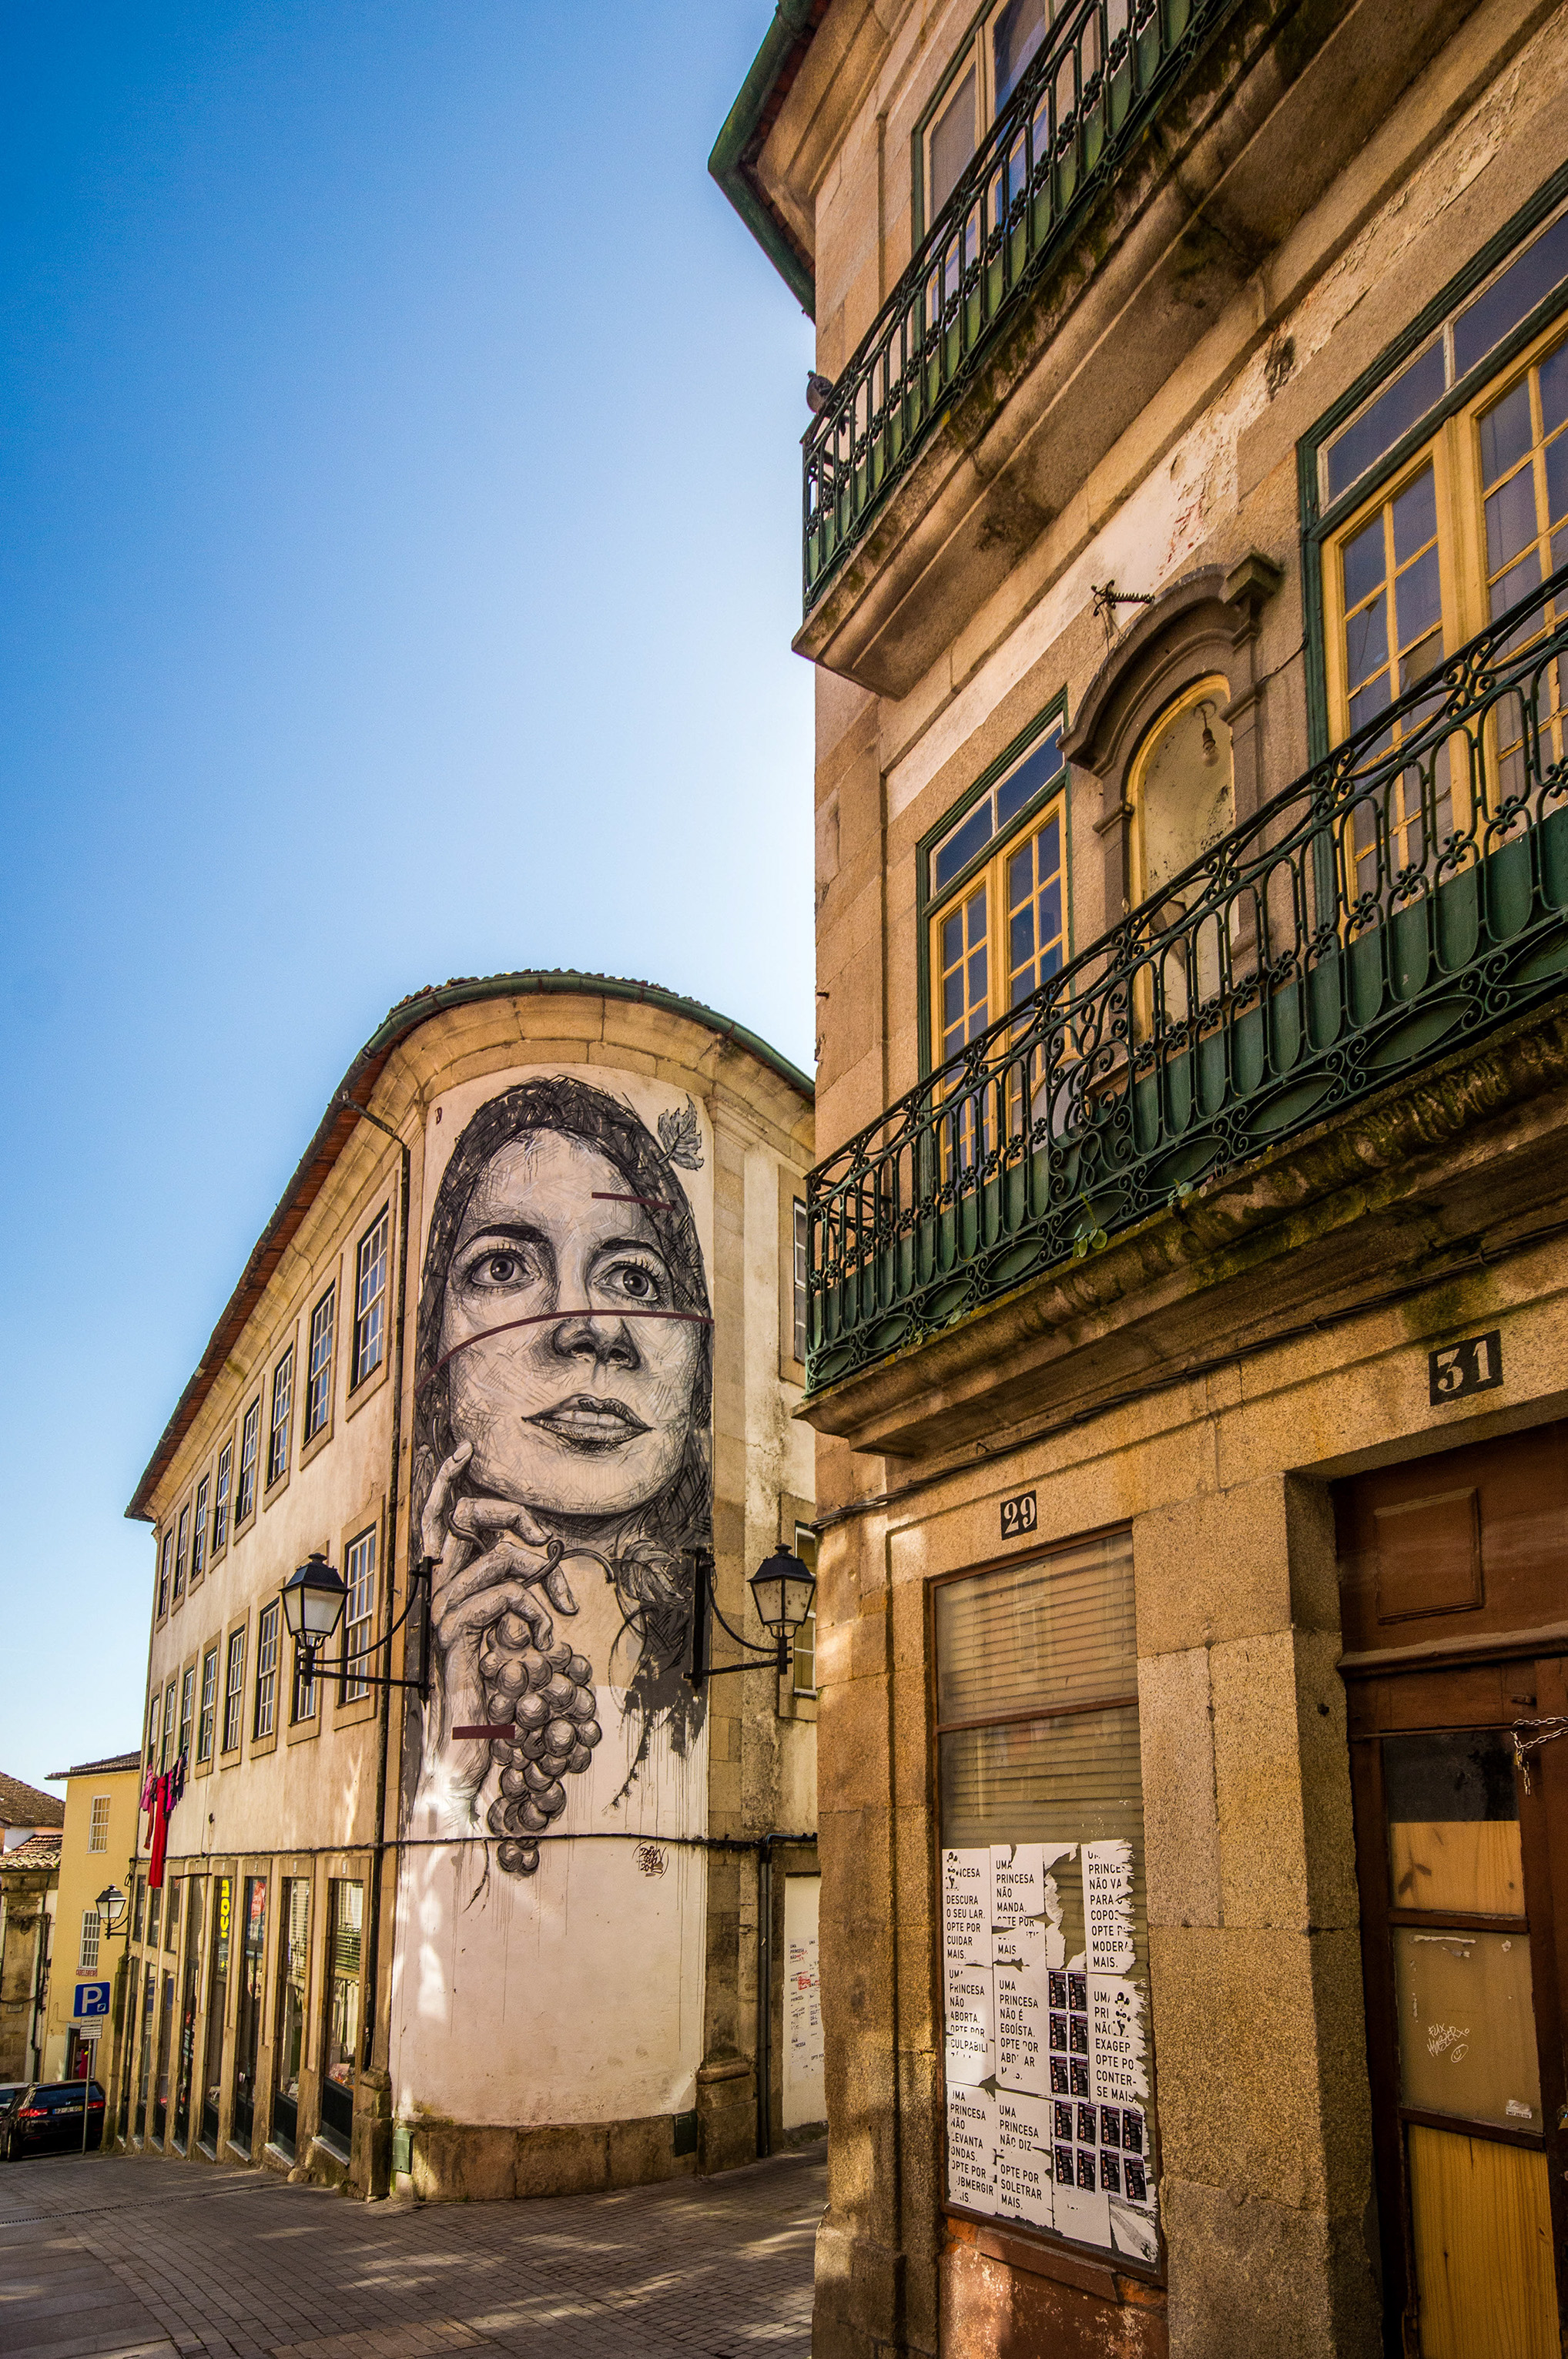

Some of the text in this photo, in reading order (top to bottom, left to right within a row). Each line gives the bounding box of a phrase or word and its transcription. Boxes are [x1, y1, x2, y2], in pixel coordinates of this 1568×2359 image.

[1437, 1340, 1492, 1392] 31
[1004, 1496, 1036, 1533] 29
[996, 1860, 1012, 1870] UMA
[996, 1874, 1034, 1884] PRINCESA
[1089, 1877, 1107, 1889] NÃO
[997, 1886, 1012, 1898] NÃO
[946, 1895, 979, 1905] DESCURA
[1090, 1895, 1114, 1905] PARA
[946, 1908, 986, 1919] O SEU LAR.
[997, 1902, 1027, 1912] MANDA.
[946, 1922, 981, 1932] OPTE POR
[1091, 1925, 1114, 1936] OPTE
[946, 1935, 973, 1946] CUIDAR
[947, 1949, 967, 1959] MAIS.
[998, 1945, 1017, 1955] MAIS
[1094, 1956, 1118, 1967] MAIS.
[949, 1969, 963, 1979] UM
[950, 1982, 985, 1995] PRINCESA
[999, 1980, 1016, 1991] UMA
[82, 1986, 102, 2013] P
[950, 1995, 964, 2008] NÃO
[1000, 1994, 1038, 2009] PRINCESA
[950, 2011, 980, 2024] ABORTA.
[1000, 2007, 1024, 2021] NÃO É
[1000, 2022, 1035, 2038] EGOÍSTA.
[1000, 2037, 1020, 2049] OPTE
[1096, 2054, 1137, 2071] OPTE PO
[1096, 2069, 1137, 2086] CONTER-
[1097, 2086, 1137, 2104] SE MAIS.
[950, 2103, 986, 2121] PRINCESA
[999, 2104, 1017, 2118] UMA
[950, 2116, 965, 2129] NÃO
[1000, 2119, 1039, 2139] PRINCESA
[1000, 2133, 1032, 2152] NÃO DIZ
[950, 2146, 977, 2162] ONDAS.
[971, 2165, 986, 2179] POR
[1000, 2163, 1039, 2184] OPTE POR
[957, 2176, 993, 2196] UBMERGIR
[1000, 2178, 1042, 2200] SOLETRAR
[1001, 2193, 1023, 2210] MAIS.
